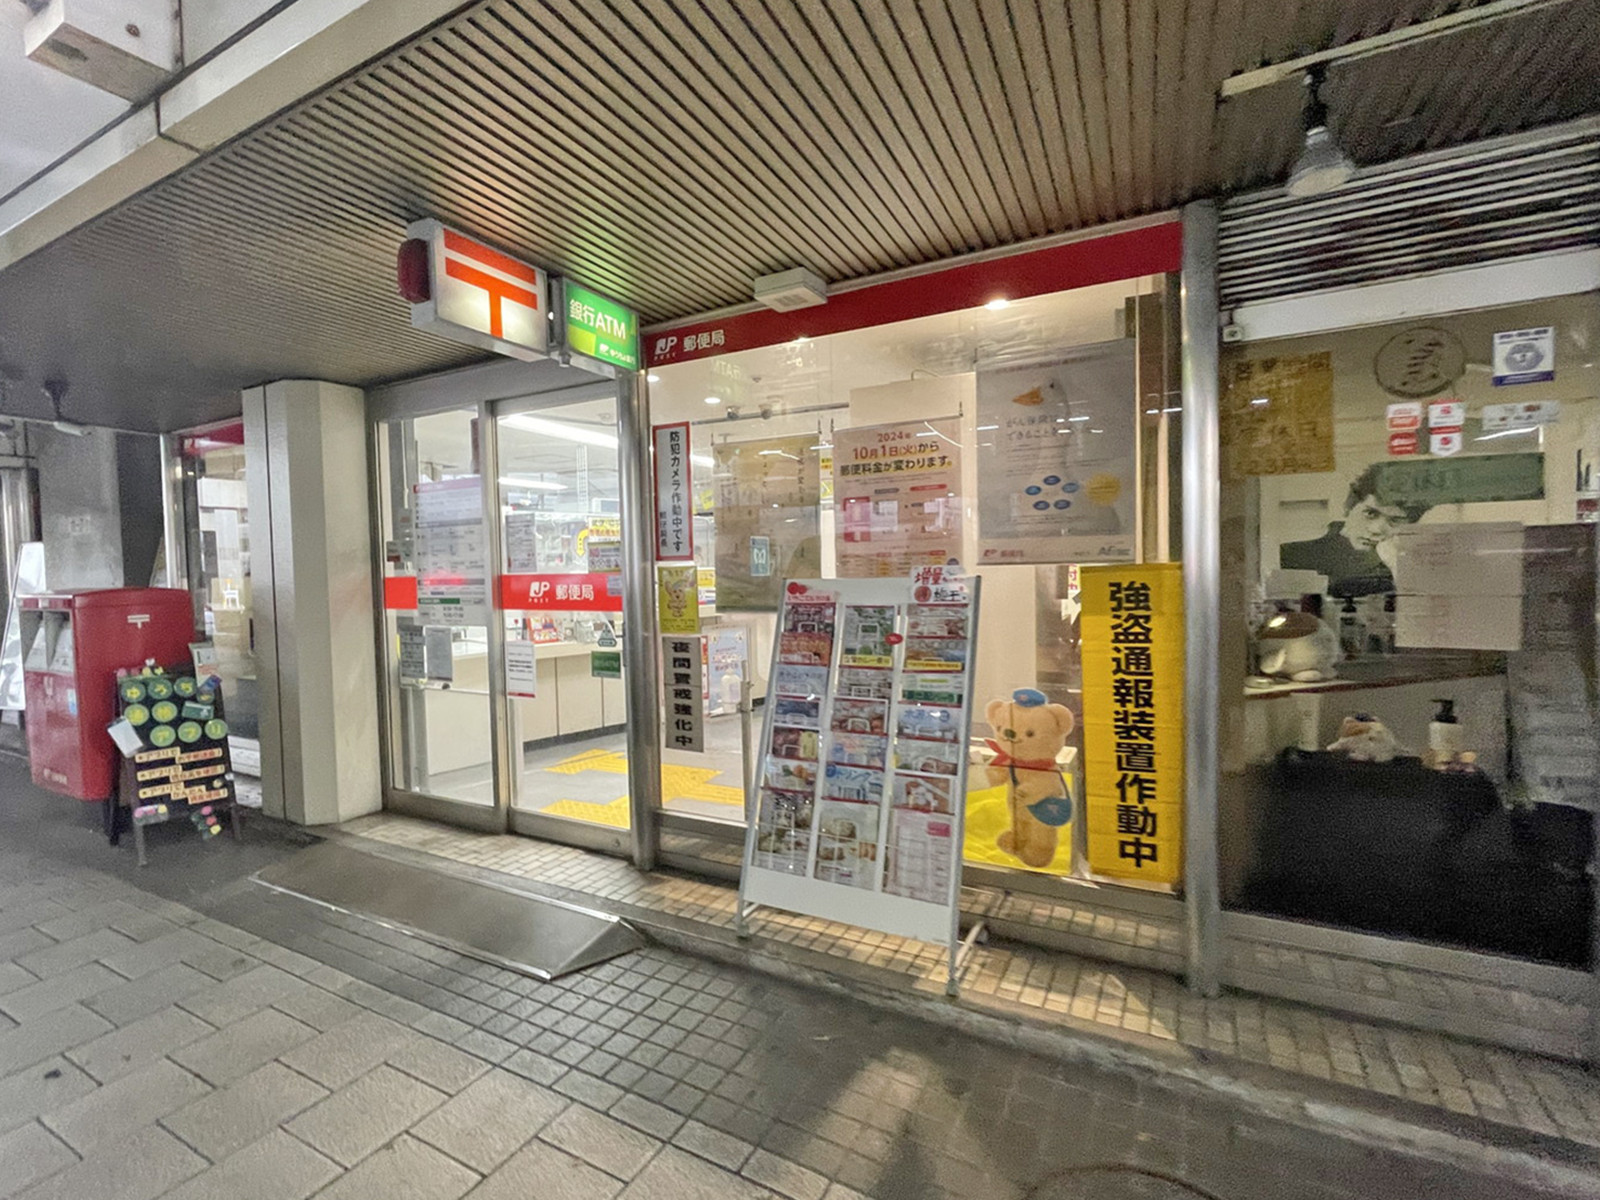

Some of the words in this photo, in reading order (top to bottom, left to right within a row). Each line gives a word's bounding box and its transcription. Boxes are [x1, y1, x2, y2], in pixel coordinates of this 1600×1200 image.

[569, 299, 627, 340] 銀行ATM
[683, 329, 725, 351] 郵便局
[877, 431, 912, 443] 2024年
[853, 441, 940, 460] 10月1日(火)から
[840, 455, 953, 477] 郵便料金が変わります。
[669, 430, 683, 553] 防犯カメラ作動中です
[555, 584, 595, 601] 郵便局
[671, 641, 693, 747] 夜間警戒強化中
[1108, 580, 1159, 869] 強盗通報装置作動中
